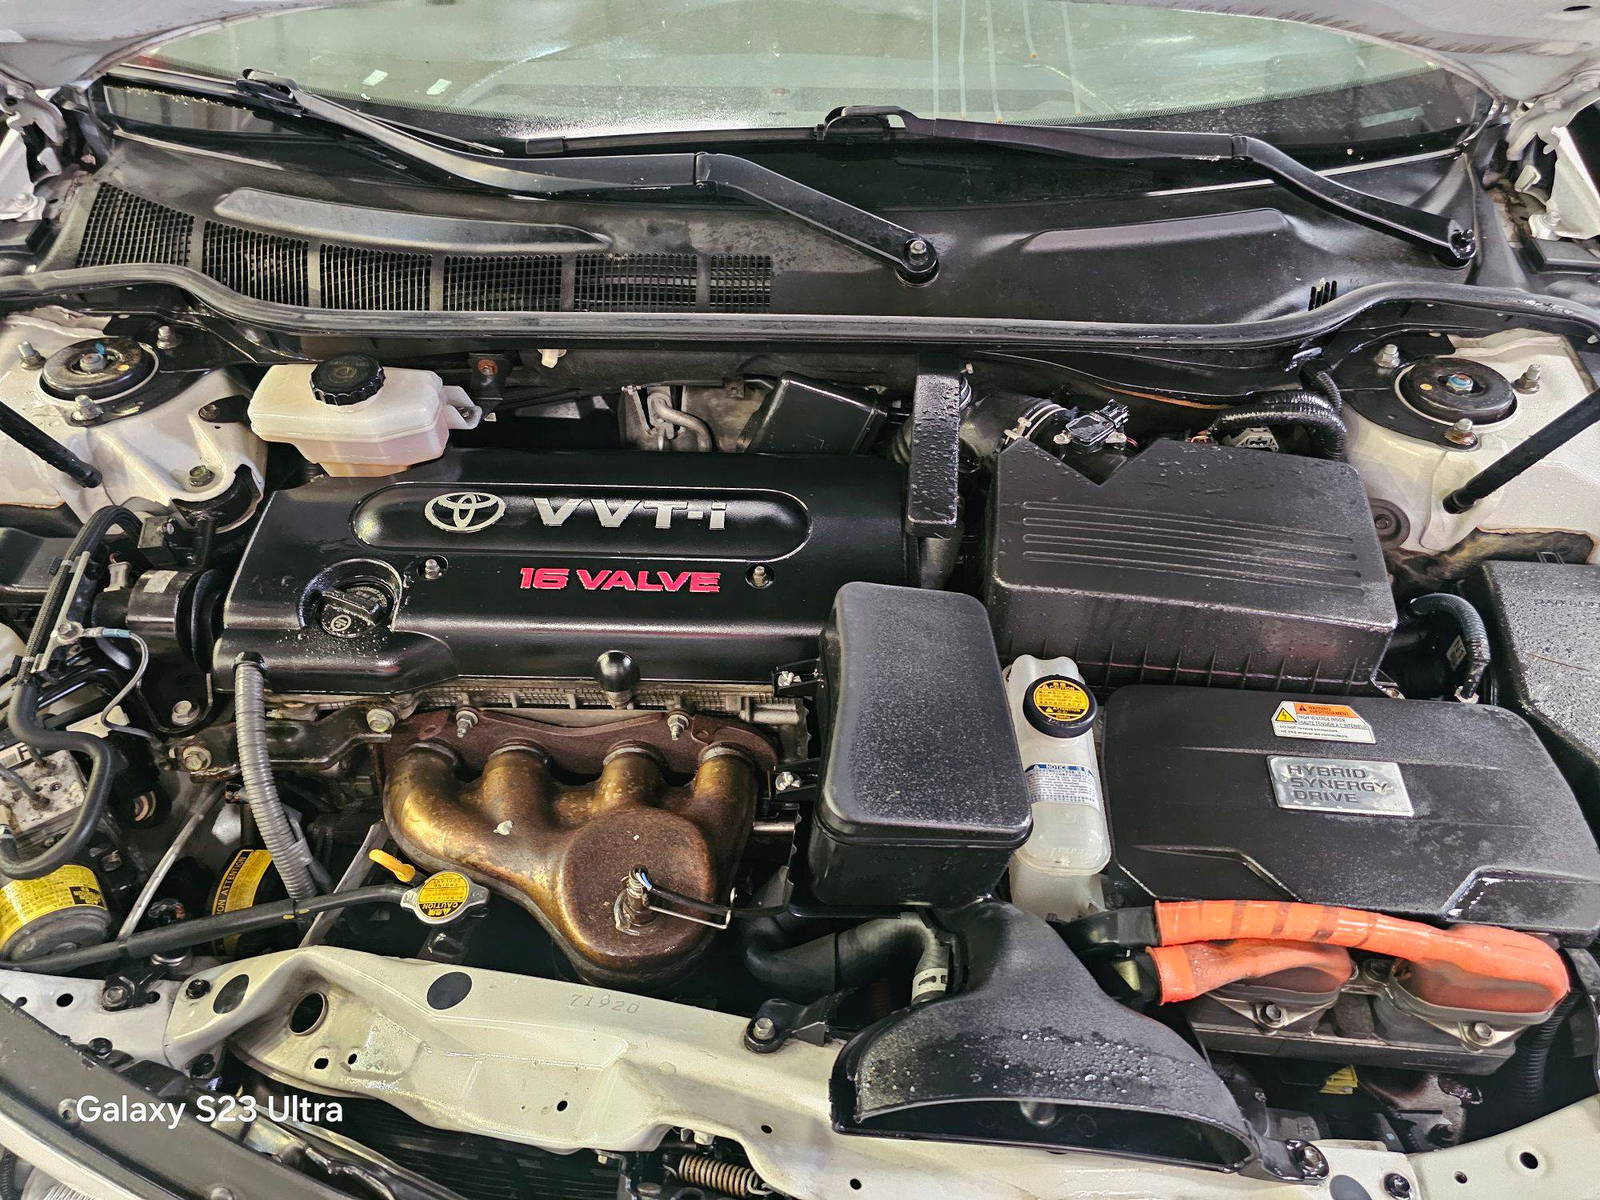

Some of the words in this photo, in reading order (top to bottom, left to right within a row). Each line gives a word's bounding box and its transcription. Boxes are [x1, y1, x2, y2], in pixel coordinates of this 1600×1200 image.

[533, 497, 727, 531] VVT-i
[519, 567, 570, 590] 16
[576, 569, 721, 592] VALVE
[1286, 764, 1367, 779] HYBRID
[1290, 777, 1388, 793] SYNERGY
[1294, 790, 1358, 803] DRIVE
[422, 902, 458, 910] CAUTION
[568, 992, 640, 1014] 71920
